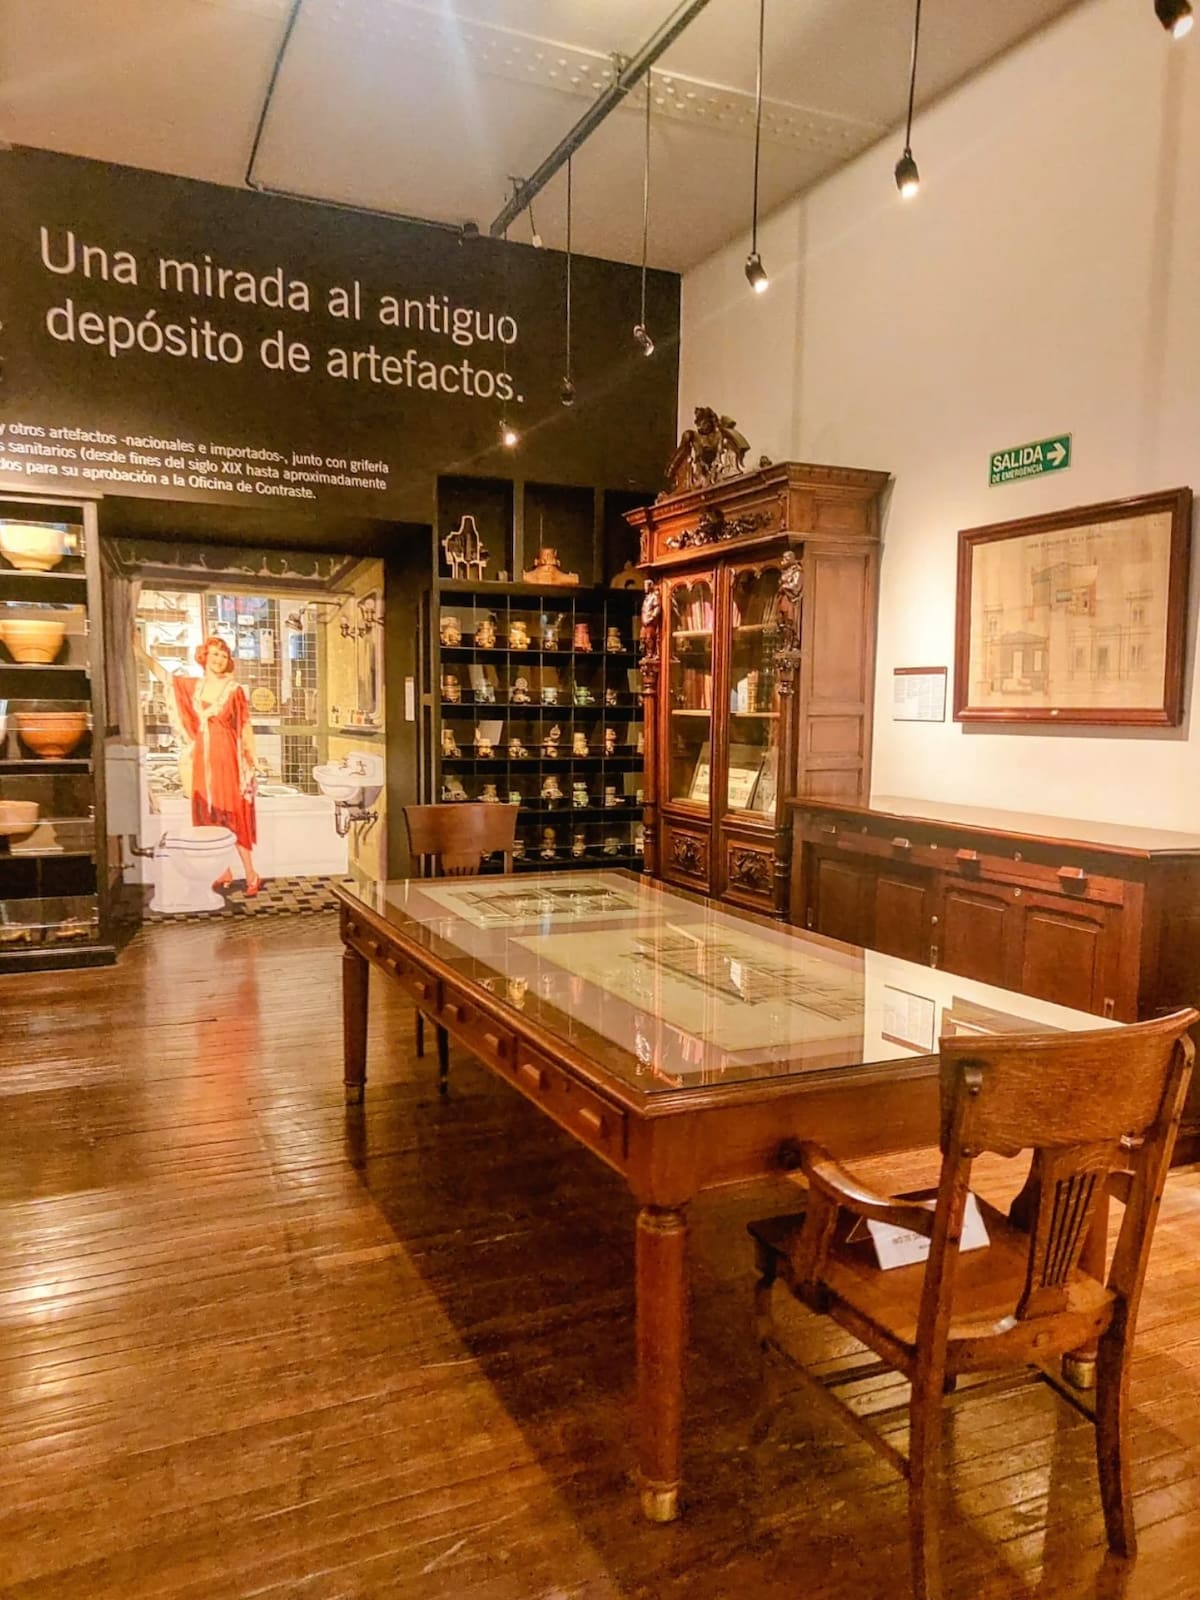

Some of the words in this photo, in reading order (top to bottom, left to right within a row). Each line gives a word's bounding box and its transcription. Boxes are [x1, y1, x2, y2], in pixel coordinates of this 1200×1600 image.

[40, 226, 138, 285] Una
[159, 256, 310, 313] mirada
[328, 281, 361, 321] al
[379, 295, 518, 346] antiguo
[46, 298, 244, 365] depósito
[260, 330, 311, 373] de
[327, 346, 525, 402] artefactos.
[7, 441, 77, 459] sanitarios
[80, 447, 126, 464] (desde
[129, 452, 161, 467] fines
[165, 456, 185, 470] del
[188, 458, 218, 474] siglo
[221, 461, 242, 475] XIX
[246, 464, 280, 479] hasta
[283, 468, 387, 490] aproximadamente
[9, 422, 46, 437] otros
[49, 426, 118, 445] artefactos
[120, 434, 195, 453] -nacionales
[198, 443, 207, 454] e
[210, 443, 288, 465] importados-,
[292, 452, 323, 467] junto
[325, 457, 347, 469] con
[992, 445, 1043, 472] SALIDA
[26, 462, 58, 476] para
[61, 465, 79, 477] su
[82, 466, 157, 484] aprobación
[160, 474, 170, 485] a
[173, 474, 186, 487] la
[188, 475, 233, 492] Oficina
[236, 480, 253, 493] de
[255, 482, 317, 499] Contraste.
